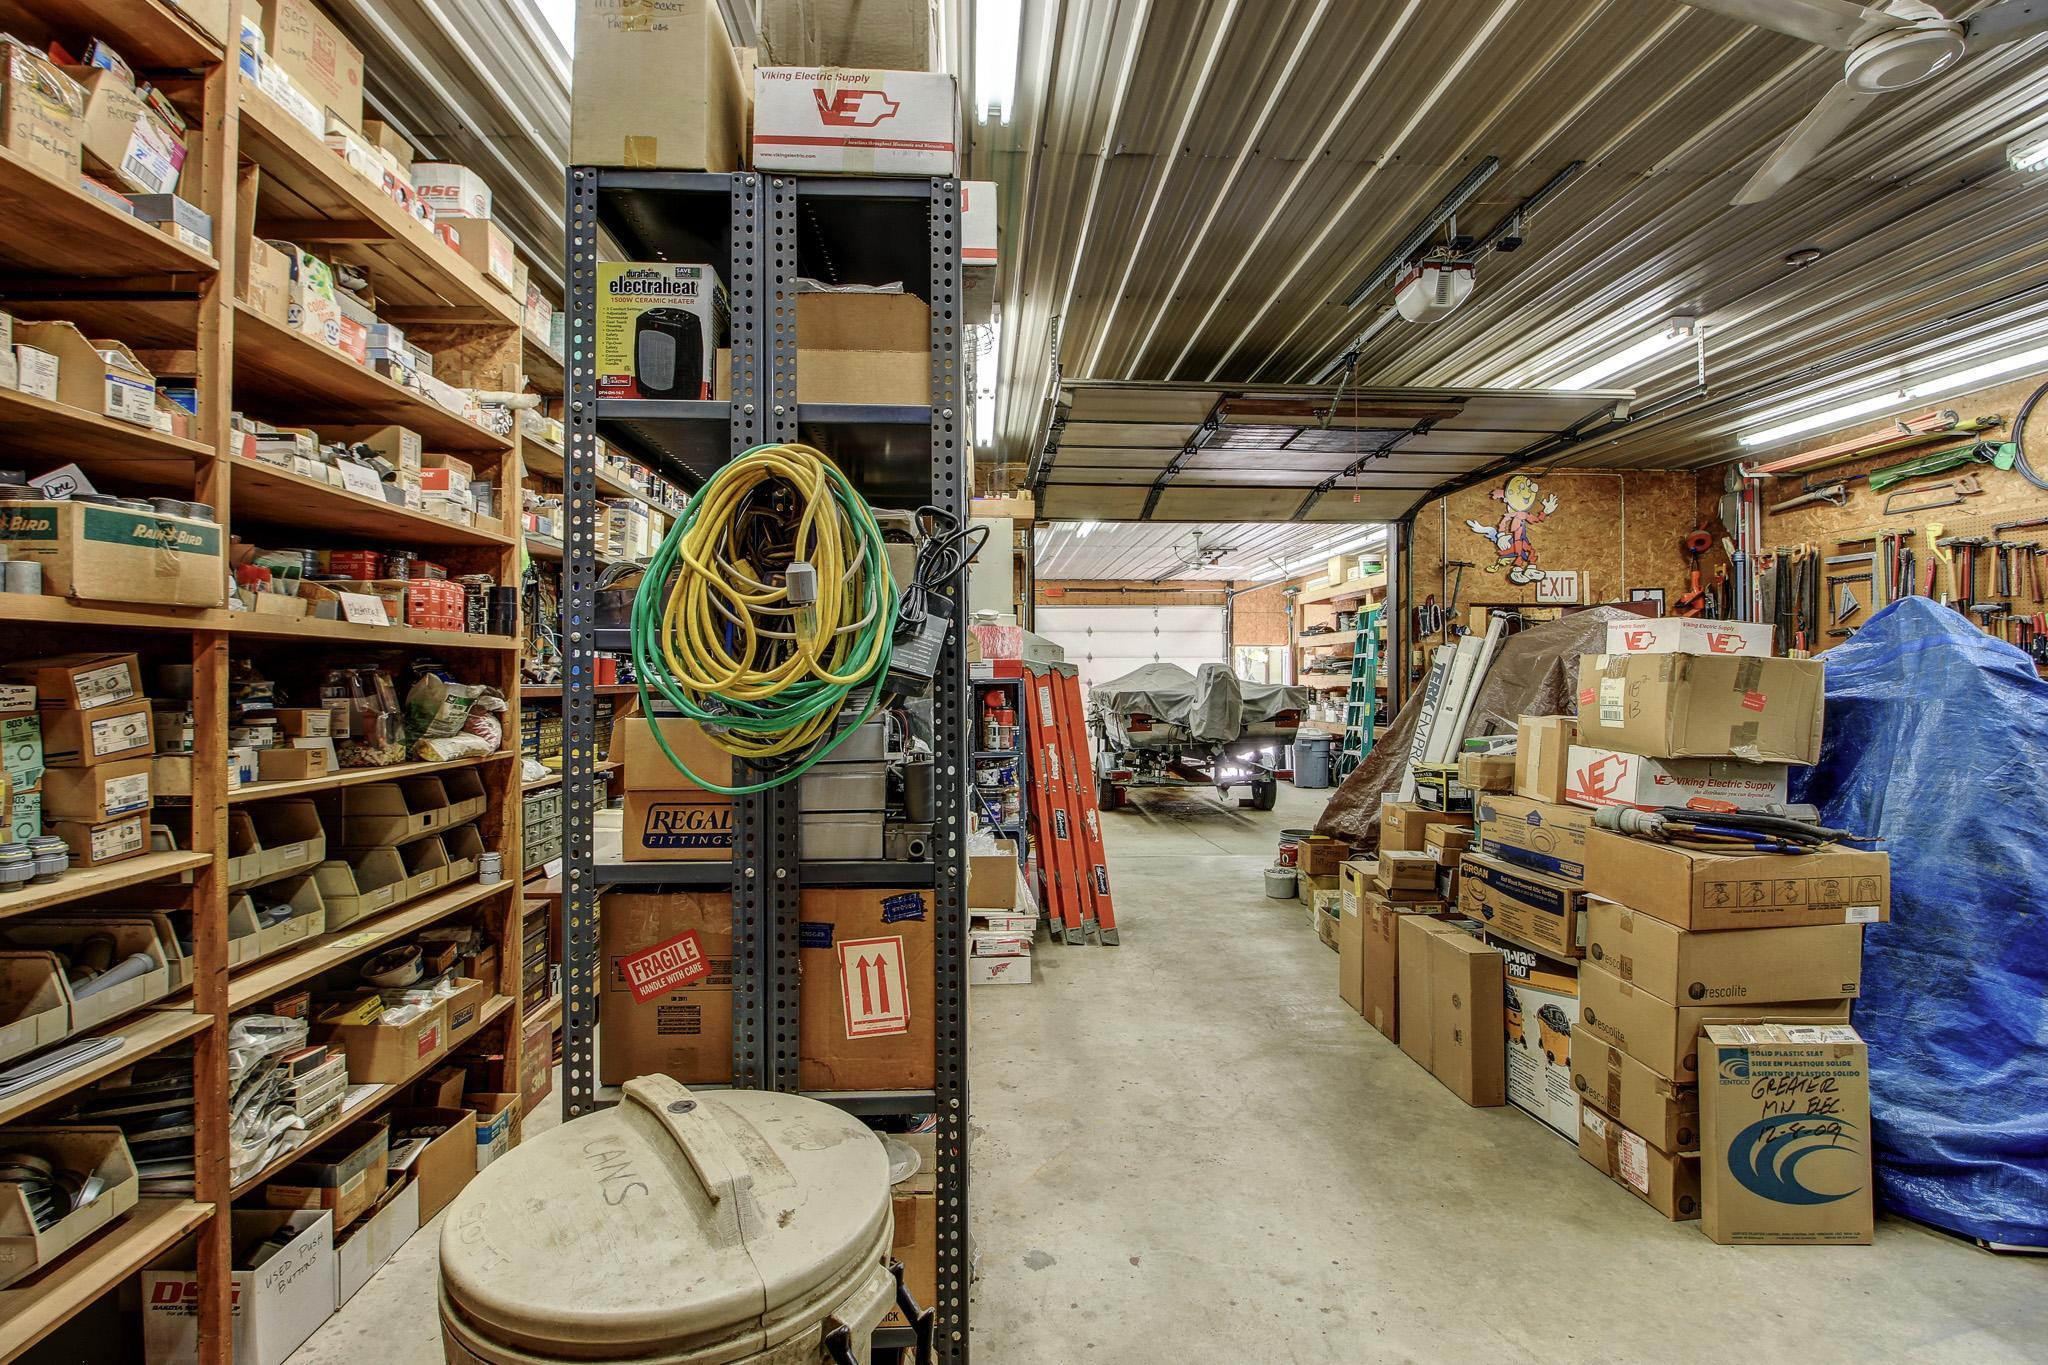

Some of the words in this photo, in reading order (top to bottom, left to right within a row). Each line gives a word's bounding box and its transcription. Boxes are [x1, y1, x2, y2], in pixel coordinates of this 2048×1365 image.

[761, 71, 792, 82] Viking
[795, 72, 833, 82] Electric
[835, 73, 870, 84] Supply
[417, 186, 461, 197] DSG
[627, 269, 660, 278] duraflame
[610, 276, 698, 295] electraheat
[1540, 577, 1575, 596] EXIT
[1423, 663, 1446, 711] TERK
[1675, 776, 1705, 789] Viking
[1707, 779, 1742, 788] Electric
[1745, 780, 1776, 791] Supply
[651, 809, 733, 834] REGAL
[649, 836, 733, 845] FITTINGS
[631, 939, 697, 983] FRAGILE
[1509, 963, 1527, 978] PRO
[640, 977, 668, 996] HANDLE
[667, 970, 686, 985] WITH
[685, 962, 704, 977] CARE
[1751, 1076, 1839, 1100] GREATER
[265, 1260, 292, 1289] USED
[298, 1231, 324, 1259] PUSH
[278, 1252, 317, 1295] BUTTONS
